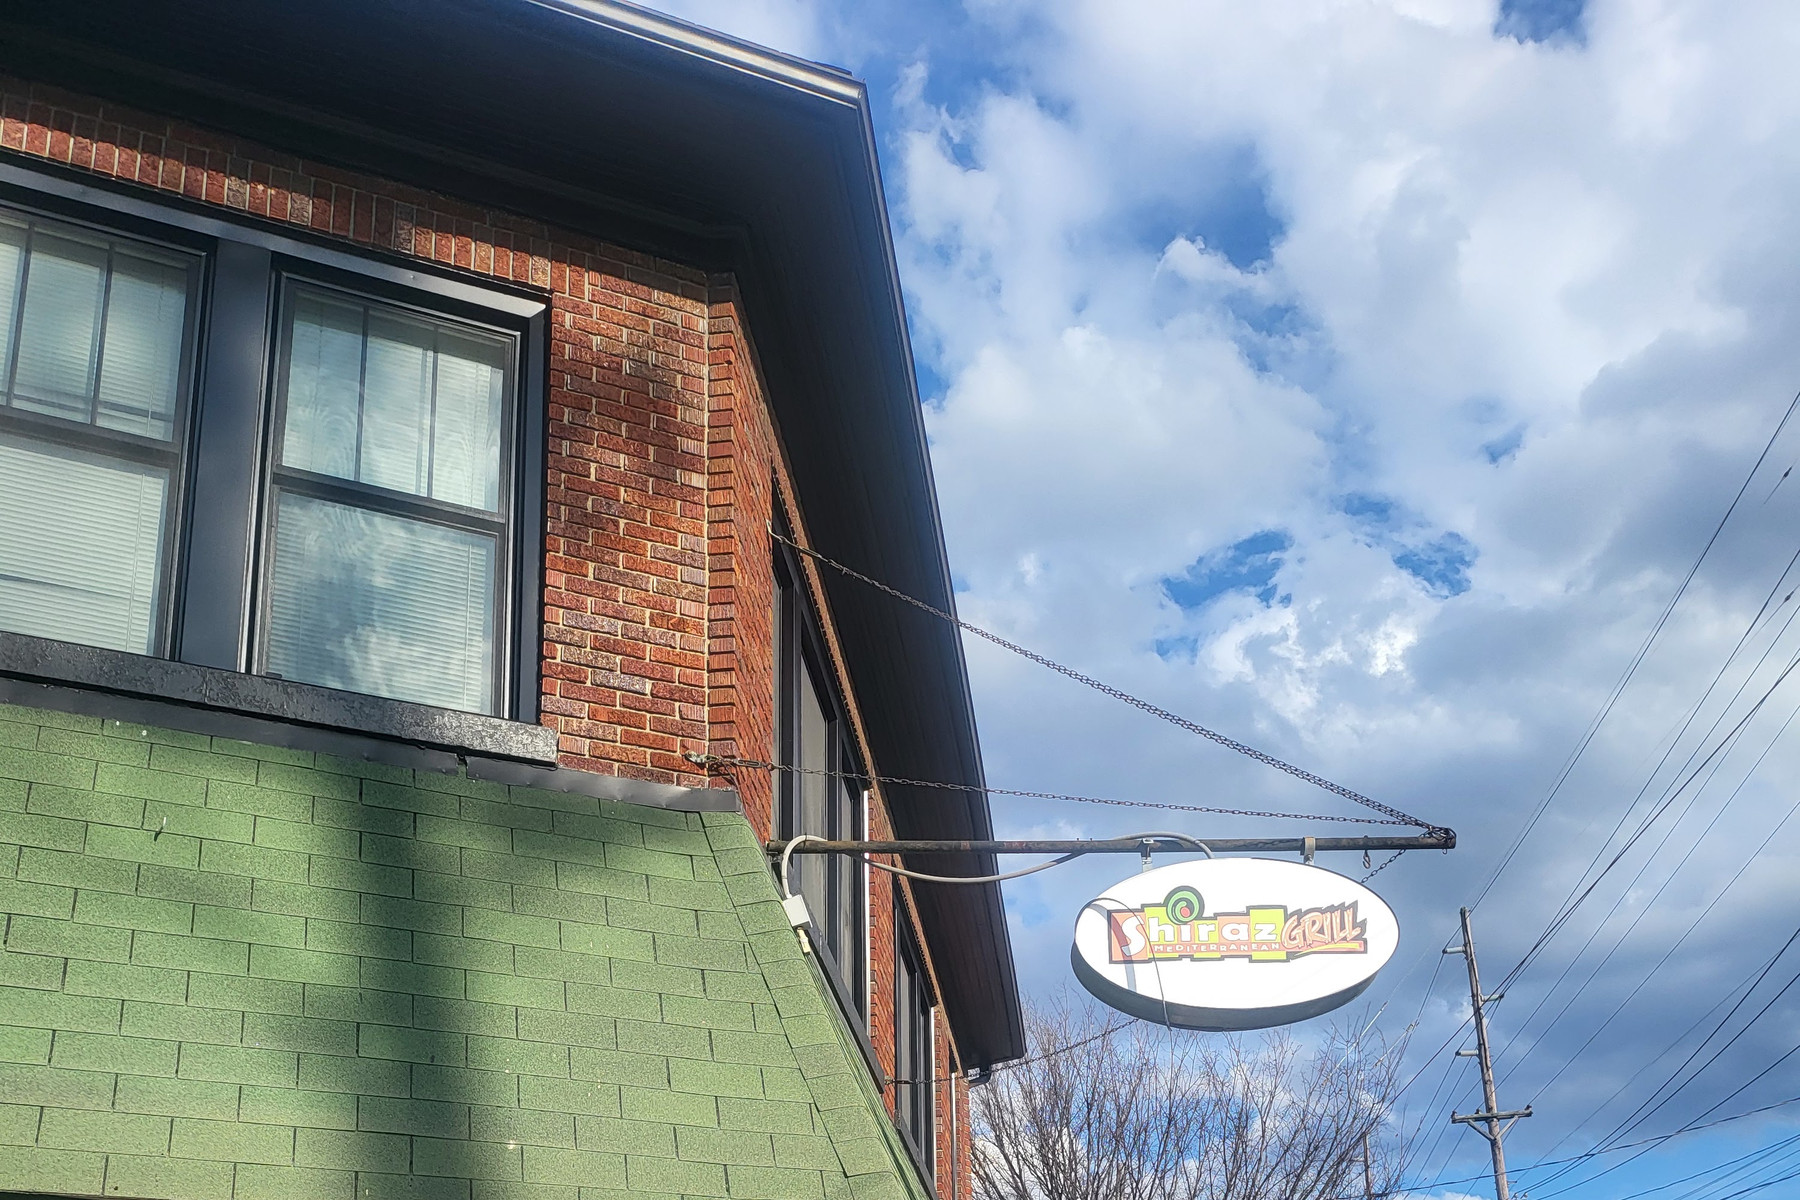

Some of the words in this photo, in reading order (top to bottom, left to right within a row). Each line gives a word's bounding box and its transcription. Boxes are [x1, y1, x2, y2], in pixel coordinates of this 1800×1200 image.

[1120, 915, 1277, 956] Shiraz
[1281, 907, 1362, 948] GRILL
[1154, 942, 1281, 952] MEDITERRANEAN
